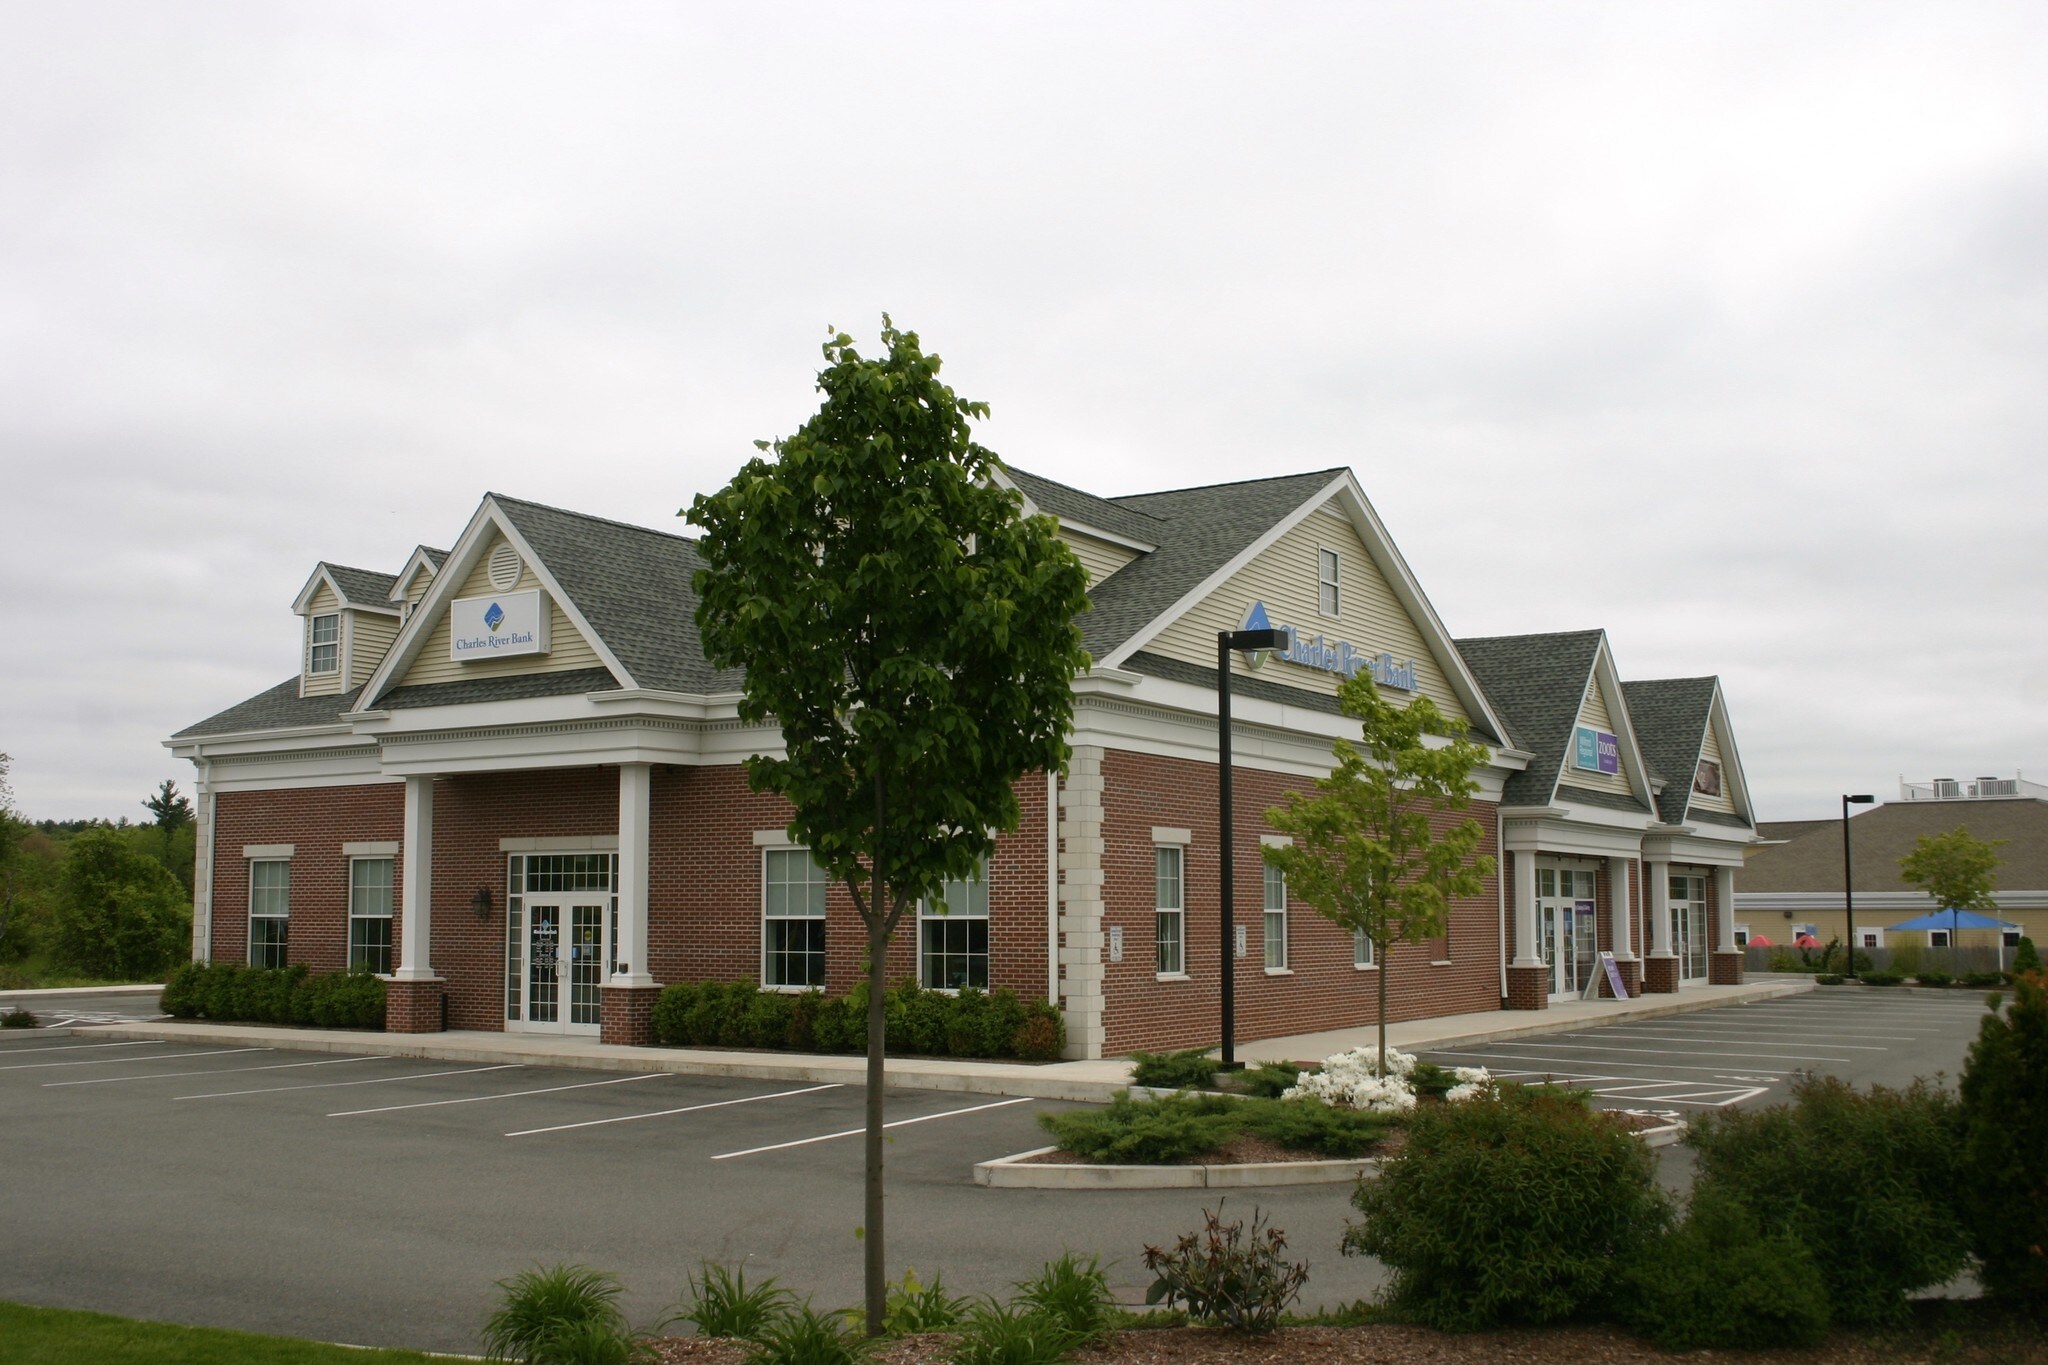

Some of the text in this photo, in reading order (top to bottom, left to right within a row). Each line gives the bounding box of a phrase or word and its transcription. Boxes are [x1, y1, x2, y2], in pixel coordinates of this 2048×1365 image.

[456, 631, 533, 650] Charles River Bank
[1382, 653, 1418, 690] Bank
